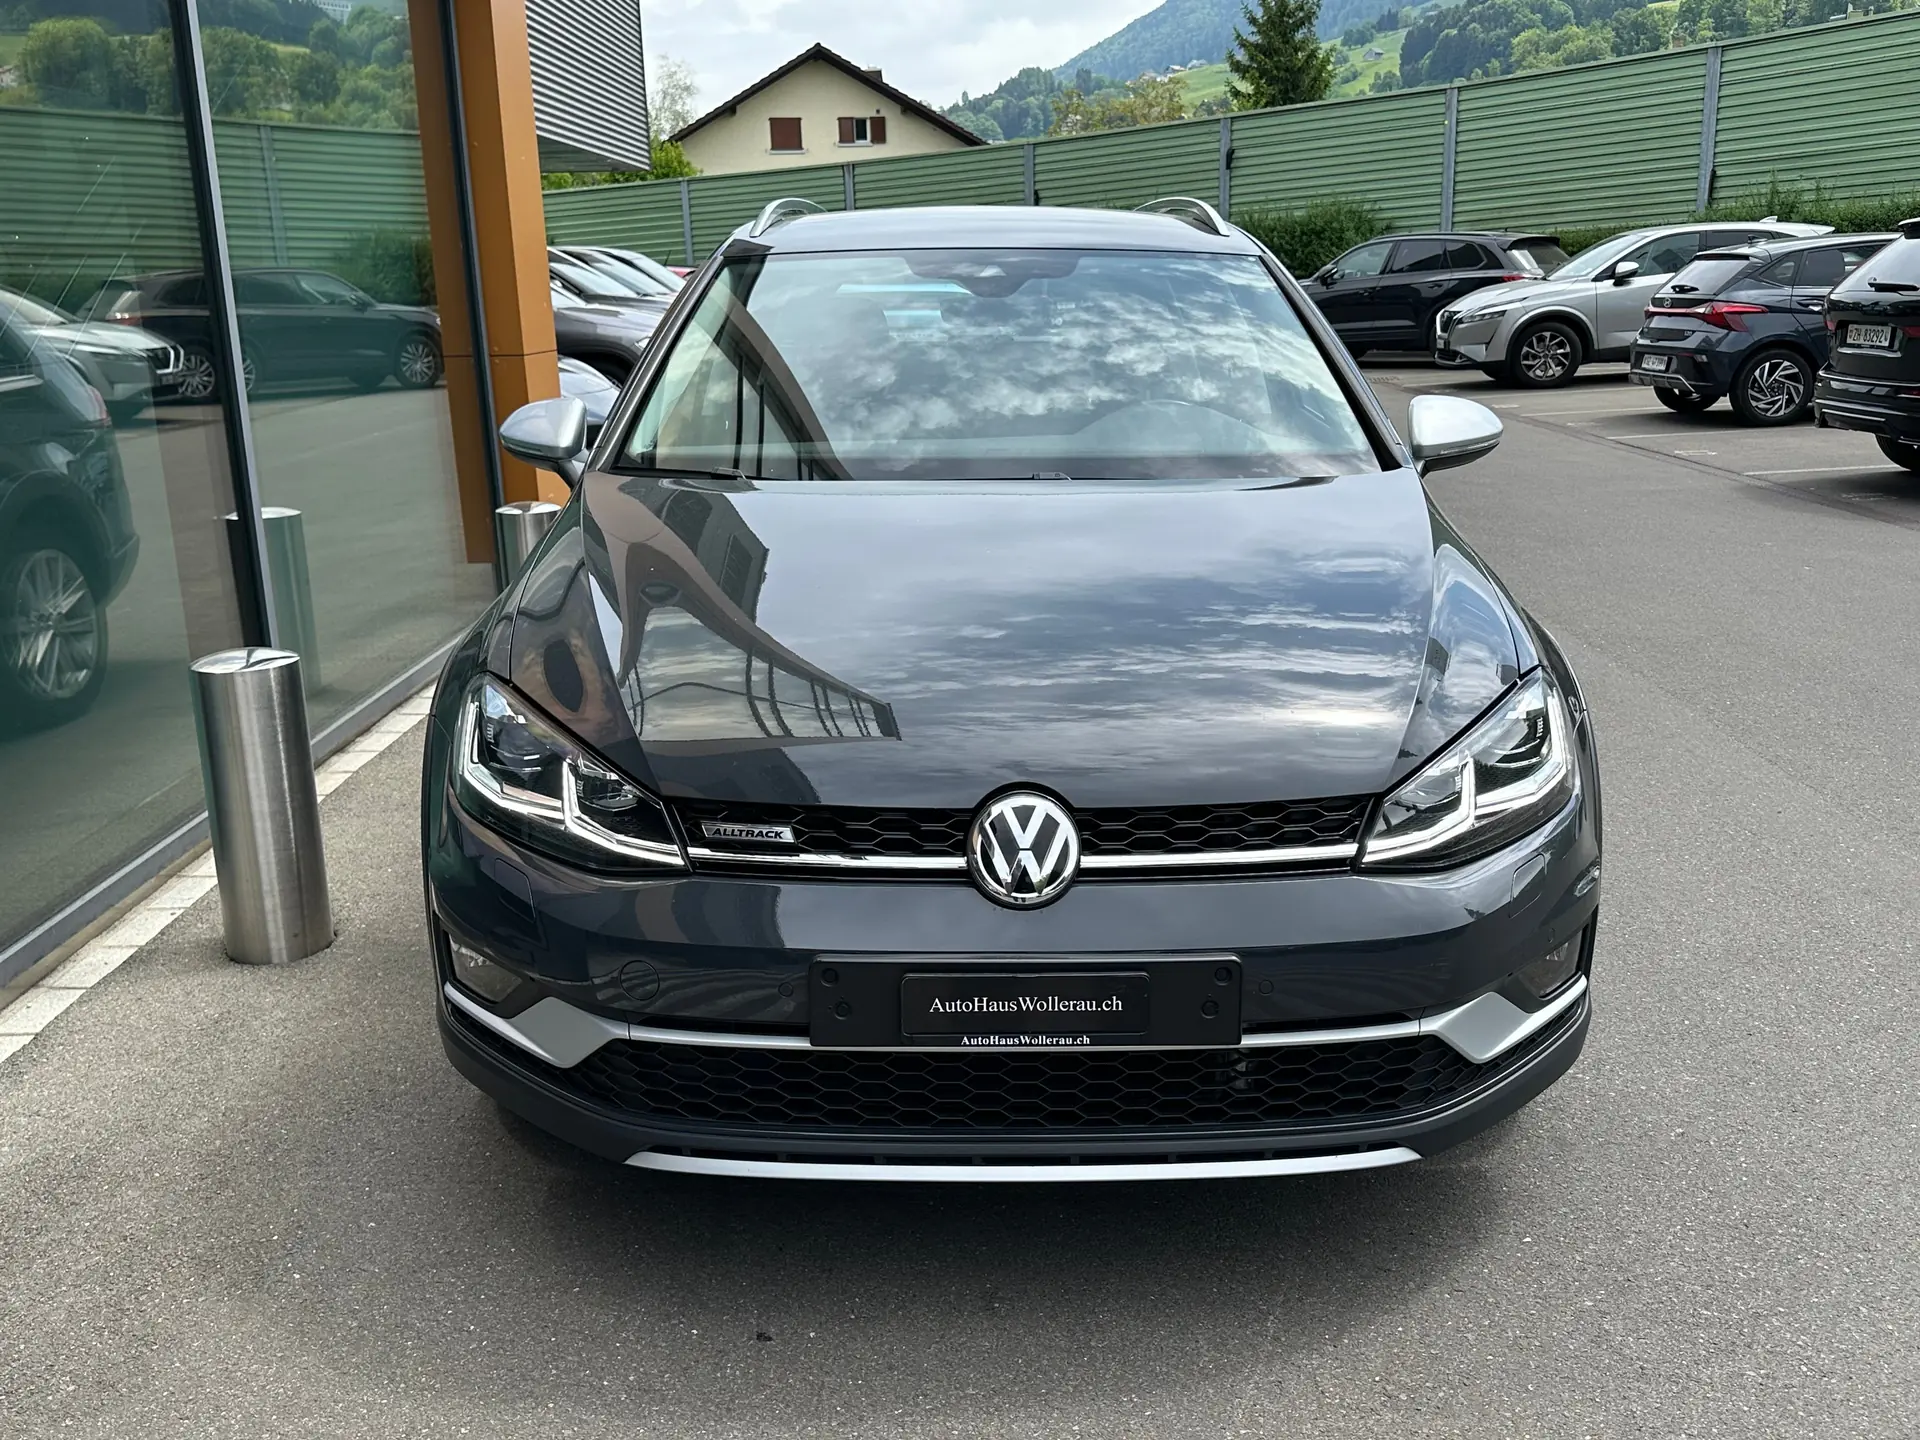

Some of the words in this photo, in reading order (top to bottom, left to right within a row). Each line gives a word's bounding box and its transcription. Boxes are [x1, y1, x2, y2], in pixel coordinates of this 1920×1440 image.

[712, 827, 784, 840] ALLTRACK
[929, 996, 1123, 1013] AutoHausWollerau.ch
[961, 1035, 1090, 1046] AutoHausWollerau.ch
